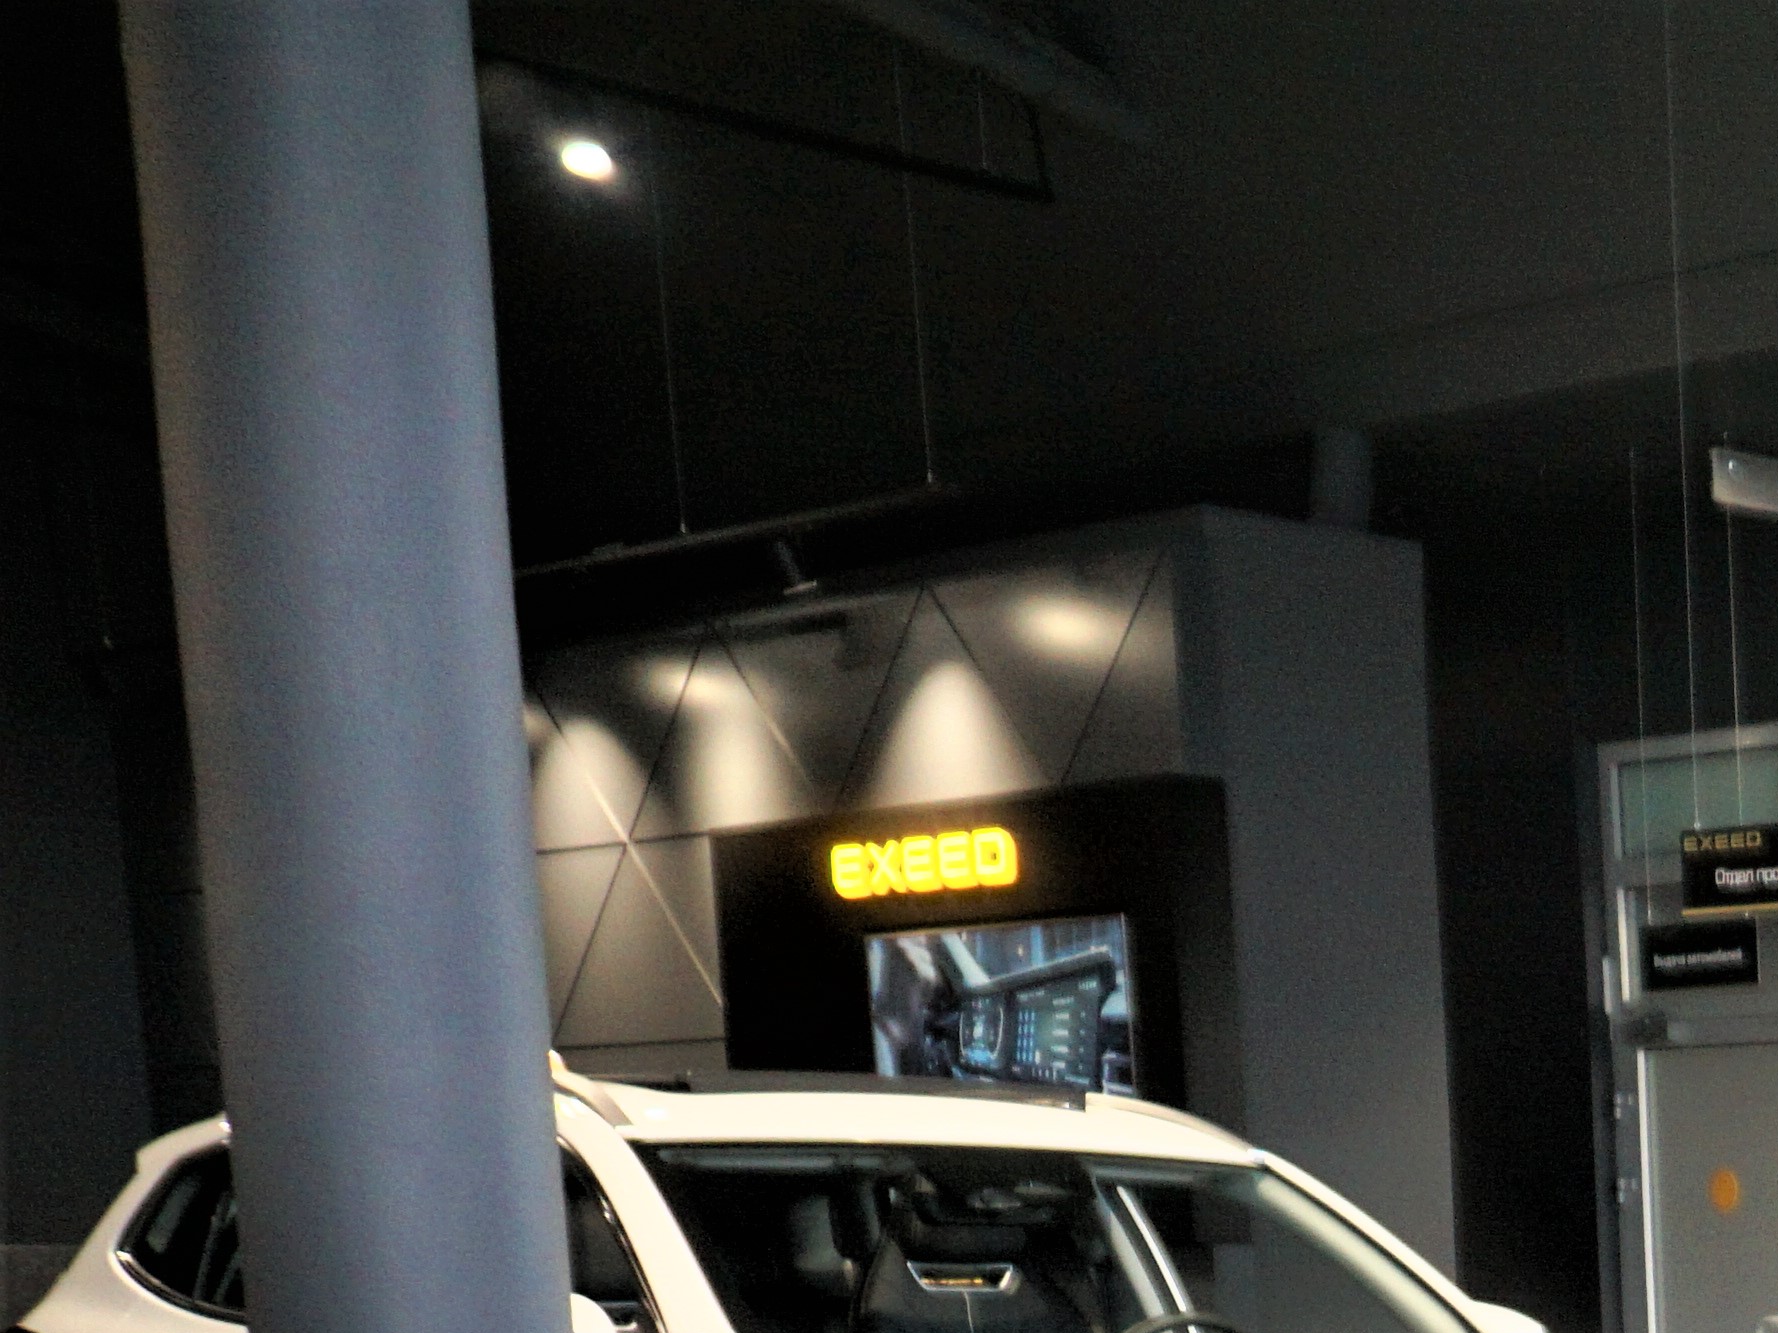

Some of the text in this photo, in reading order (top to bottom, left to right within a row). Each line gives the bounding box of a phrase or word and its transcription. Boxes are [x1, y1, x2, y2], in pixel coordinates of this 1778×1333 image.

[1684, 830, 1762, 852] EXEED
[831, 827, 1018, 899] EXEED
[1715, 867, 1754, 886] Отдел
